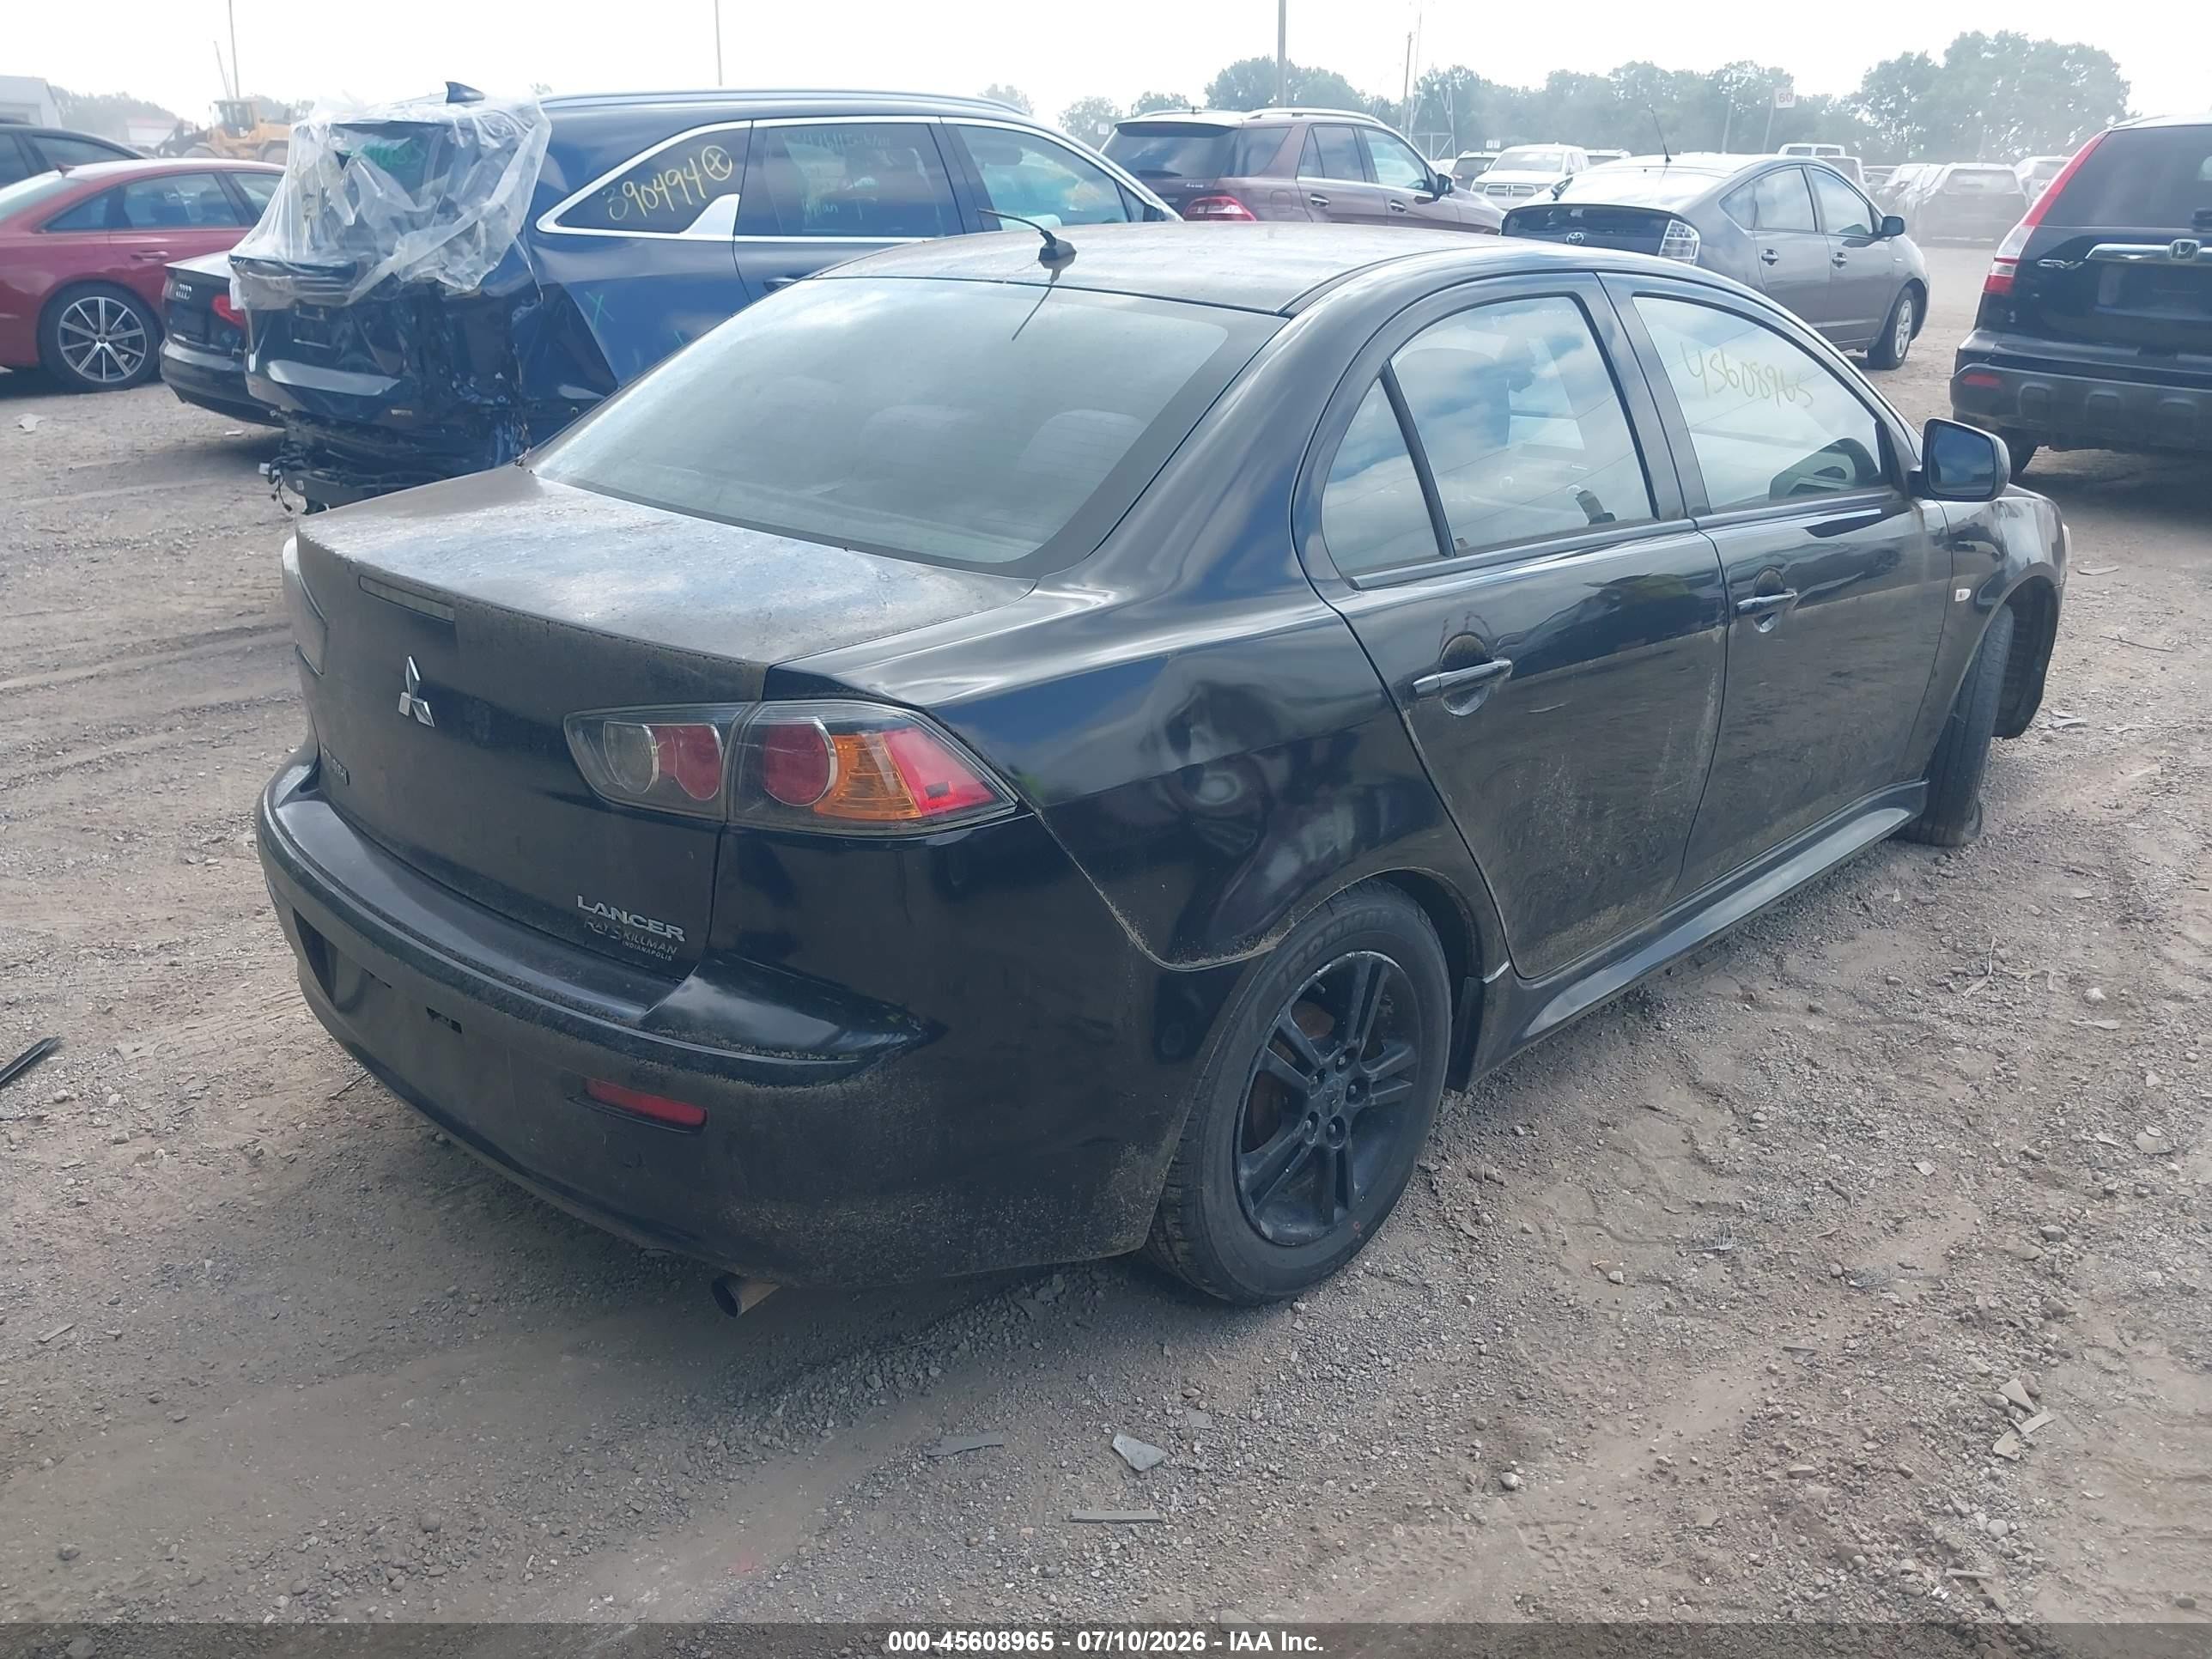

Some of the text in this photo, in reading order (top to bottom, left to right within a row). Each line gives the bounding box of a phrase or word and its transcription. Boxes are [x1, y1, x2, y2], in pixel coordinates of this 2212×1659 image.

[1778, 93, 1793, 103] 60
[603, 158, 707, 221] 390494
[1680, 341, 1814, 408] 45608965
[577, 894, 685, 942] LANCER
[622, 940, 672, 962] INDIANAPOLIS
